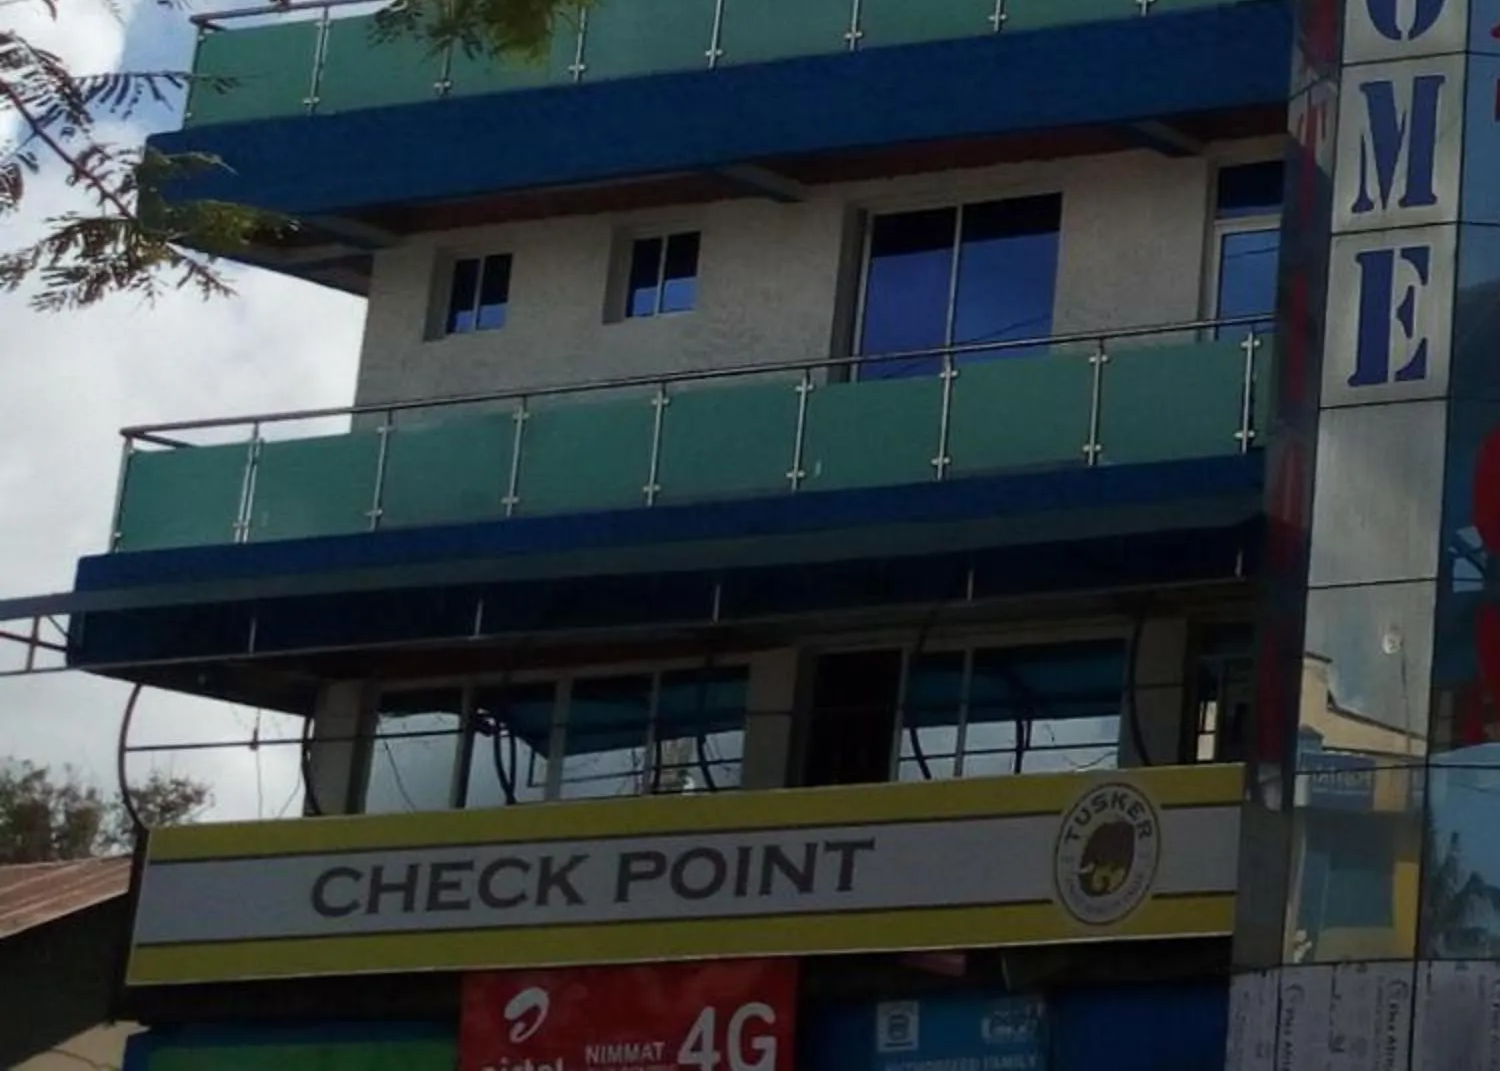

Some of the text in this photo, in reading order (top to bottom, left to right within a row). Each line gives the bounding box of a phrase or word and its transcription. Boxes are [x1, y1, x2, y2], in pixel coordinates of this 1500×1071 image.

[1064, 790, 1154, 847] TUSKER
[311, 838, 876, 918] CHECK POINT
[585, 1001, 777, 1071] NIMMAT 4G
